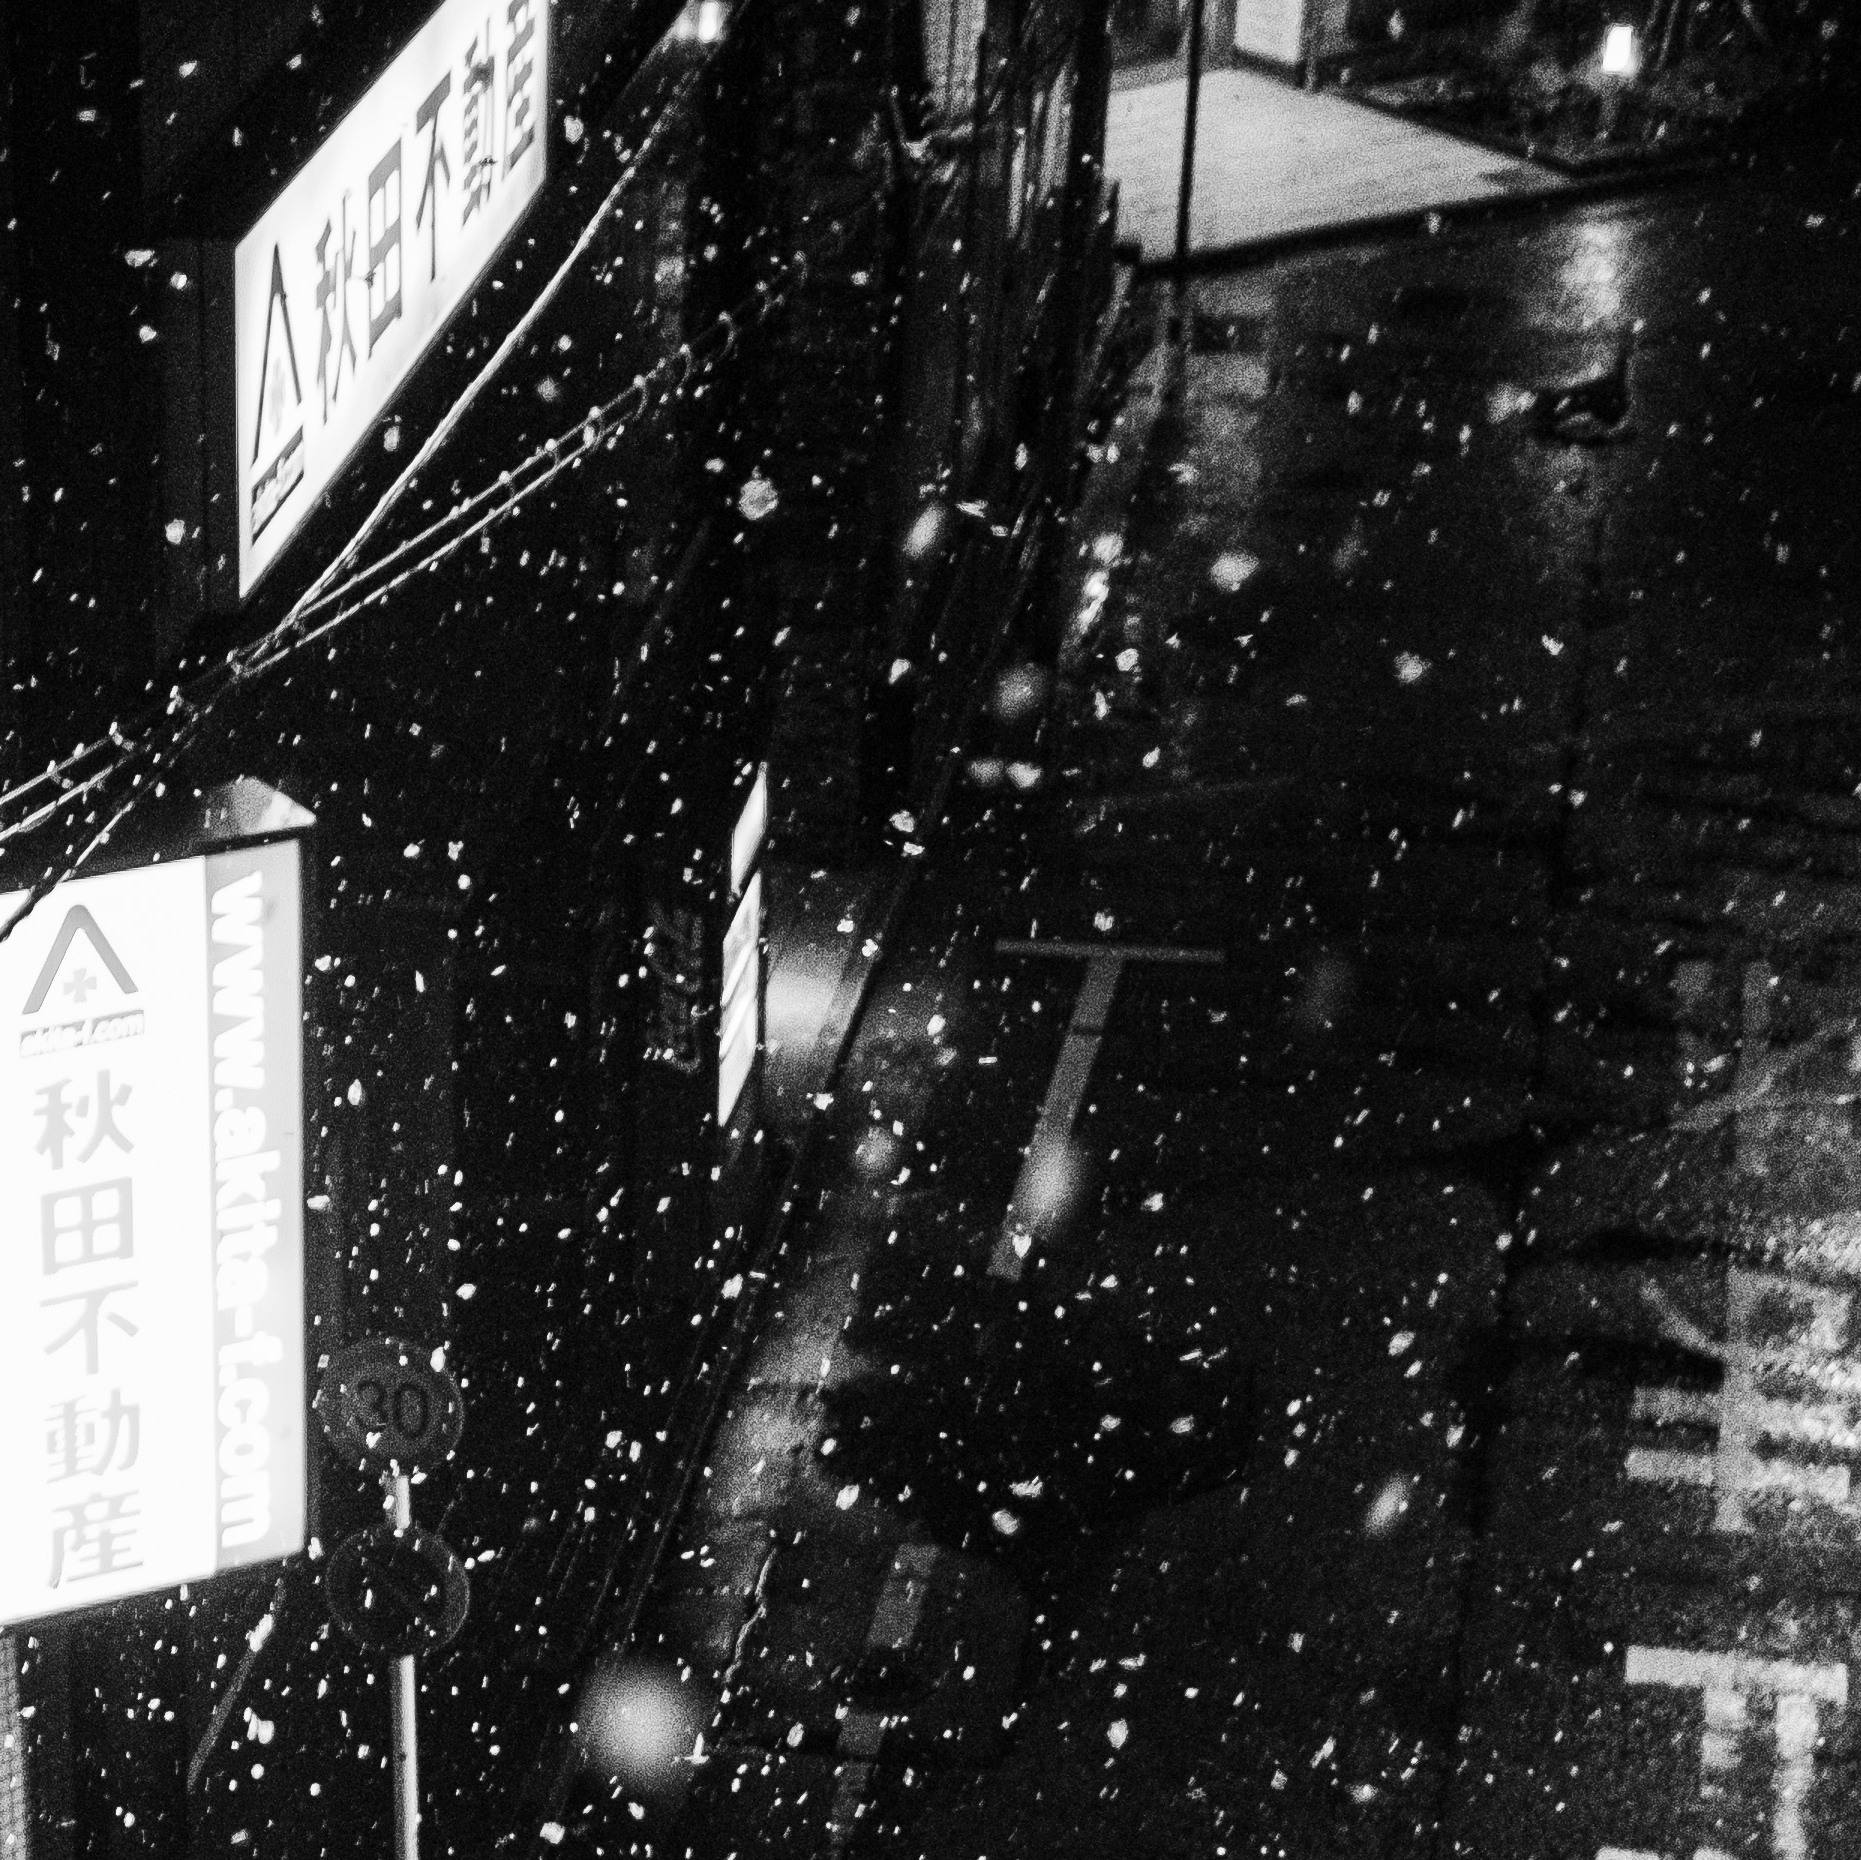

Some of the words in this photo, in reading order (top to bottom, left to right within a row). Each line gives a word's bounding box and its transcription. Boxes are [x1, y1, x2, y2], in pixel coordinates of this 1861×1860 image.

[34, 1069, 143, 1588] 秋田不動産
[211, 870, 283, 1548] www.akita-f.com
[356, 1380, 428, 1438] 30
